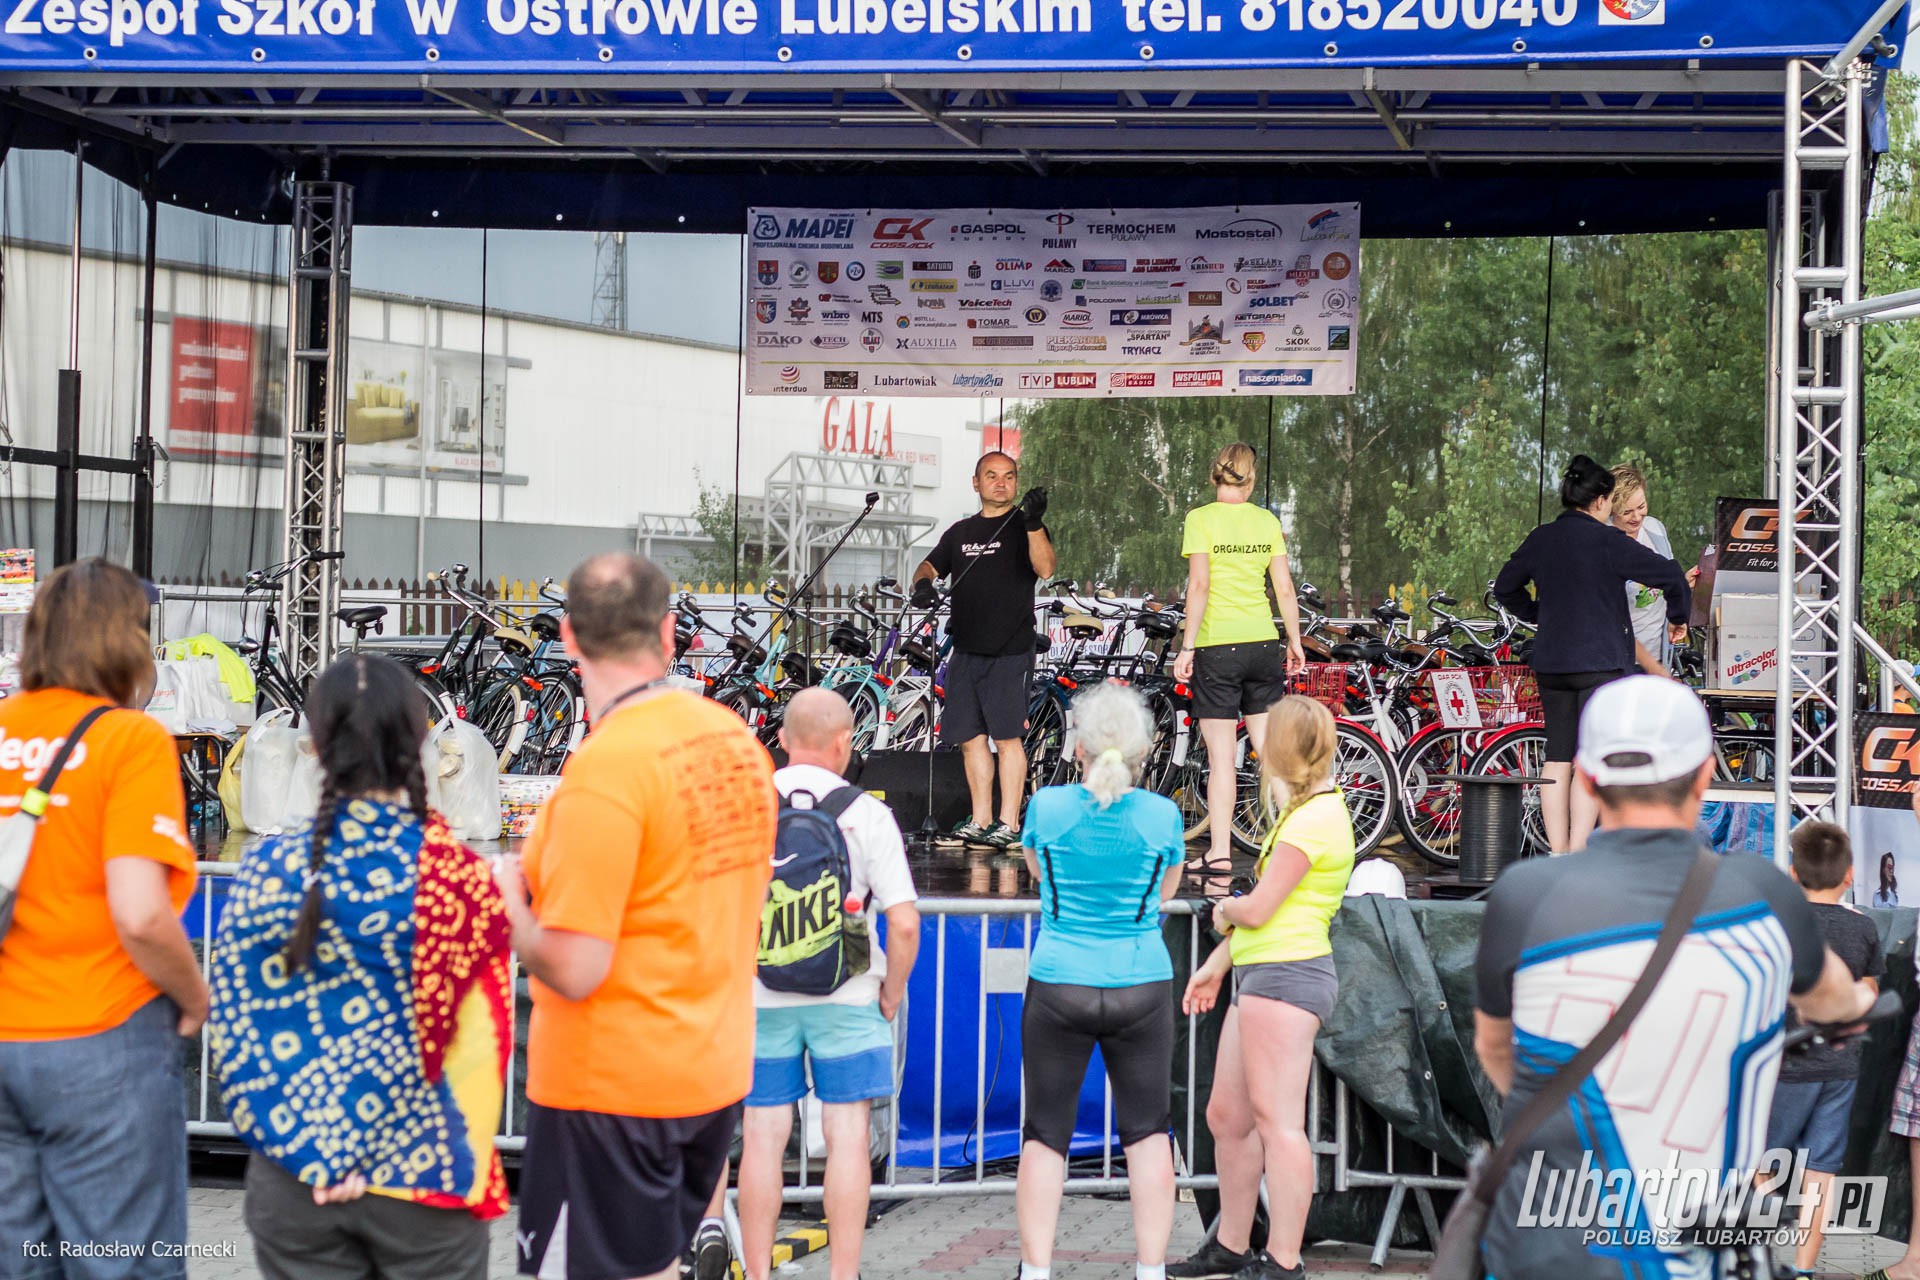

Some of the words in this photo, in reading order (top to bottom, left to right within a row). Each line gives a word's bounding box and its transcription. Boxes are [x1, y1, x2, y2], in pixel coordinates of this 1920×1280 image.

[486, 0, 758, 35] Ostrowie
[780, 0, 1091, 34] Lubelskim
[1124, 0, 1221, 32] tel.
[1240, 0, 1577, 32] 818520040
[785, 218, 855, 239] MAPEI
[961, 224, 1026, 234] GASPOL
[1087, 224, 1176, 234] TERMOCHEM
[1195, 228, 1276, 239] Mostostal
[1042, 238, 1077, 248] PUŁAWY
[927, 262, 953, 271] SATURN
[995, 261, 1033, 271] OLIMP
[958, 299, 1012, 307] VoiceTech
[1249, 296, 1296, 308] SOLBET
[821, 310, 850, 319] wibro
[861, 312, 883, 323] MTS
[1234, 313, 1285, 321] NETGRAPH
[757, 336, 803, 345] DAKO
[910, 338, 957, 347] AUXILIA
[1046, 336, 1107, 344] PIEKARNIA
[1121, 346, 1162, 355] TRYKACZ
[874, 375, 937, 386] Lubartowiak
[1021, 376, 1052, 386] TVP
[1057, 376, 1095, 385] LUBLIN
[1175, 371, 1221, 381] WSPÓLNOTA
[823, 396, 893, 457] GALA
[1213, 544, 1273, 554] ORGANIZATOR
[1747, 558, 1759, 567] Fit
[1727, 648, 1777, 678] Ultracolor
